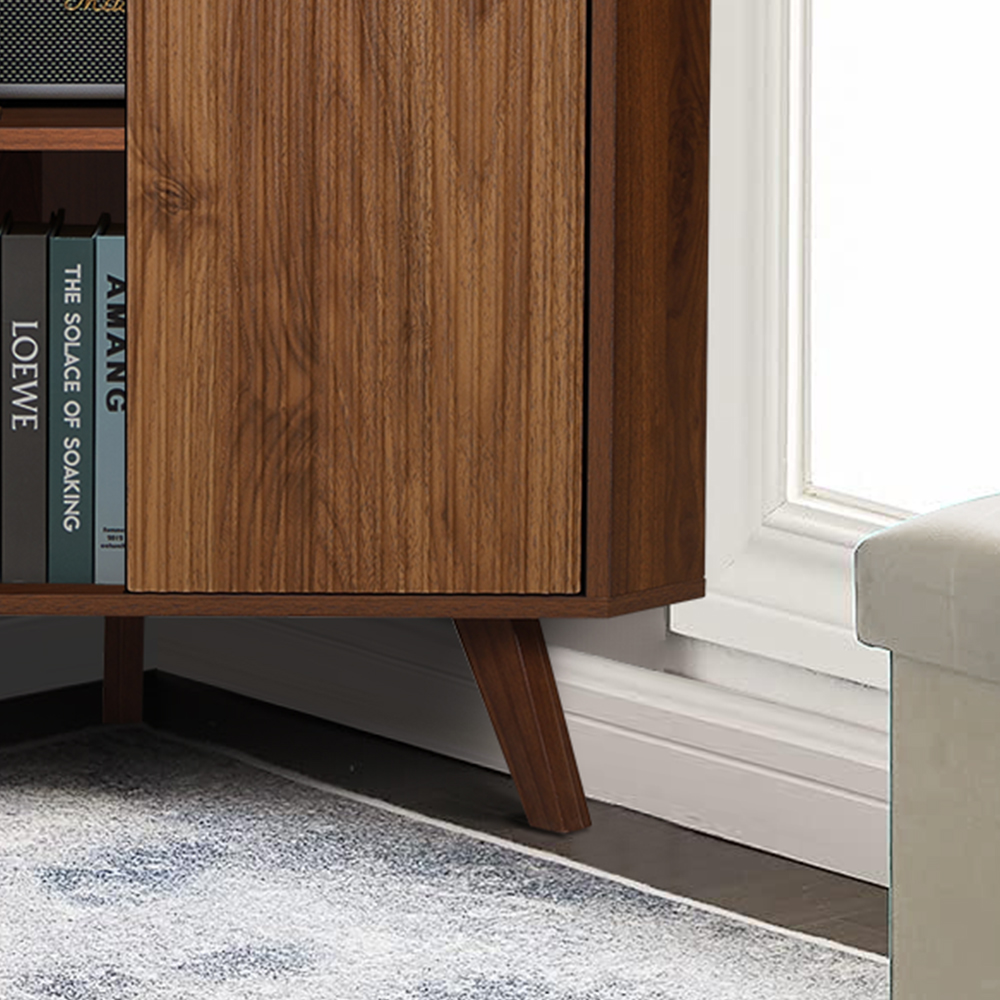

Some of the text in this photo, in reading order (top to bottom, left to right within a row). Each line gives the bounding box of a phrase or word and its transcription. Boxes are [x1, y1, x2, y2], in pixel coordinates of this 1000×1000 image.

[11, 321, 39, 431] LOEWE
[63, 264, 81, 533] THE SOLACE OF SOAKING
[106, 273, 125, 412] AMANG
